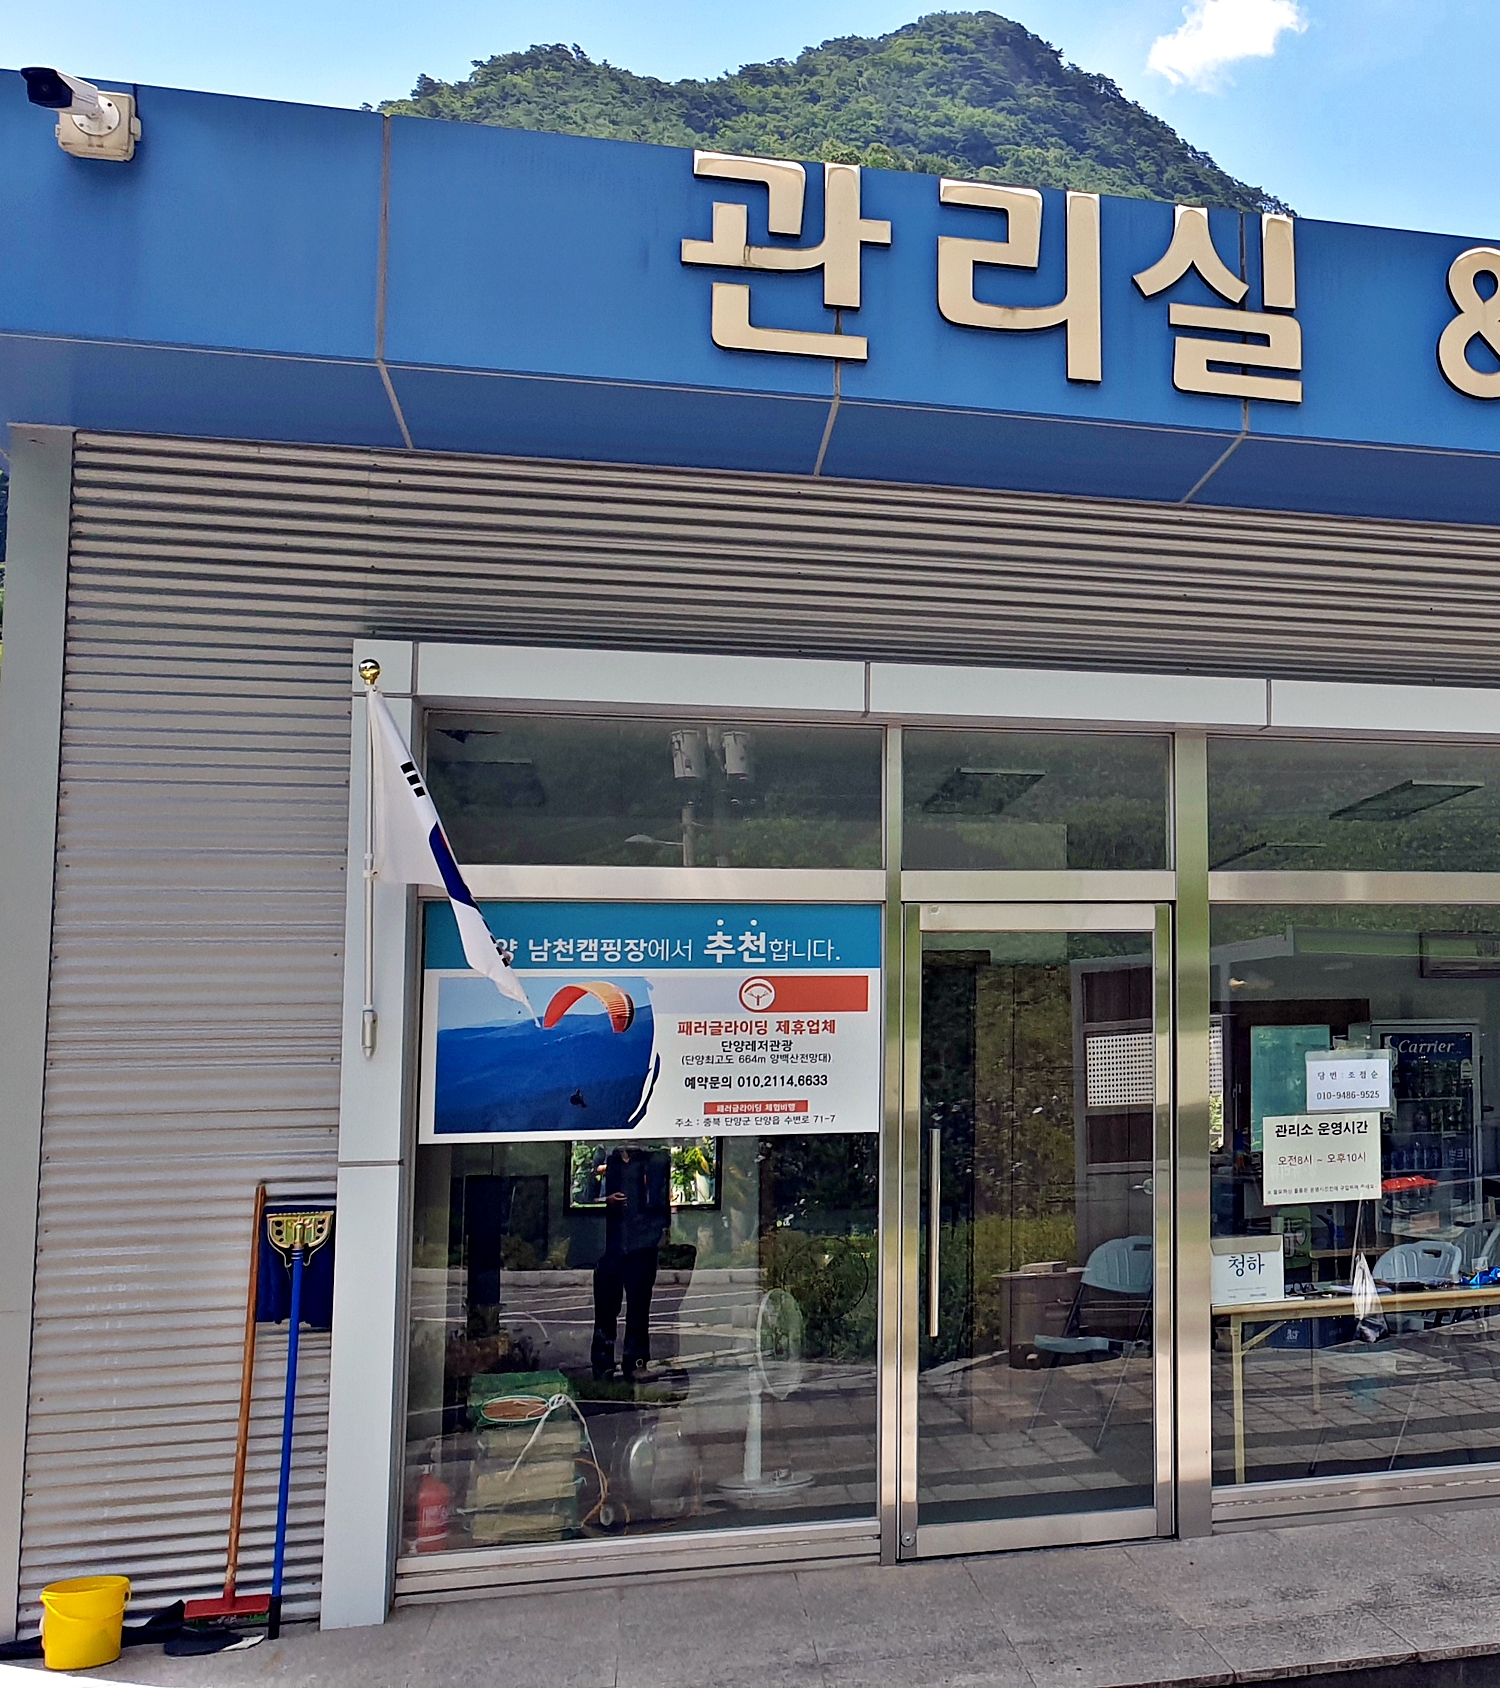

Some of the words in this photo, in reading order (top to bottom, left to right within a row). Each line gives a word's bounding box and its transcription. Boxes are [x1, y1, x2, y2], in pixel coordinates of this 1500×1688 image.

[680, 150, 1303, 403] 관리실
[528, 937, 694, 963] 남천캠핑장에서
[703, 930, 842, 964] 추천합니다.
[677, 1020, 768, 1036] 패러글라이딩
[776, 1019, 836, 1035] 제휴업체
[721, 1039, 794, 1052] 단양레저관광
[1398, 1039, 1455, 1053] Carrier
[681, 1054, 734, 1065] (단양최고도
[738, 1054, 766, 1064] 664m
[770, 1053, 832, 1064] 양백산전망대)
[684, 1076, 732, 1089] 예약문의
[737, 1075, 828, 1088] 010.2114.6633
[1316, 1090, 1380, 1100] 010-9486-9525
[716, 1103, 762, 1113] 패러글라이딩
[675, 1118, 694, 1127] 주소
[703, 1117, 721, 1127] 충북
[724, 1116, 751, 1126] 단양군
[754, 1116, 780, 1126] 단양읍
[813, 1115, 836, 1124] 71-7
[1275, 1123, 1313, 1138] 관리소
[1317, 1120, 1369, 1136] 운영시간
[1278, 1154, 1312, 1166] 오전8시
[1327, 1151, 1367, 1164] 오후10시
[1228, 1253, 1266, 1277] 청하
